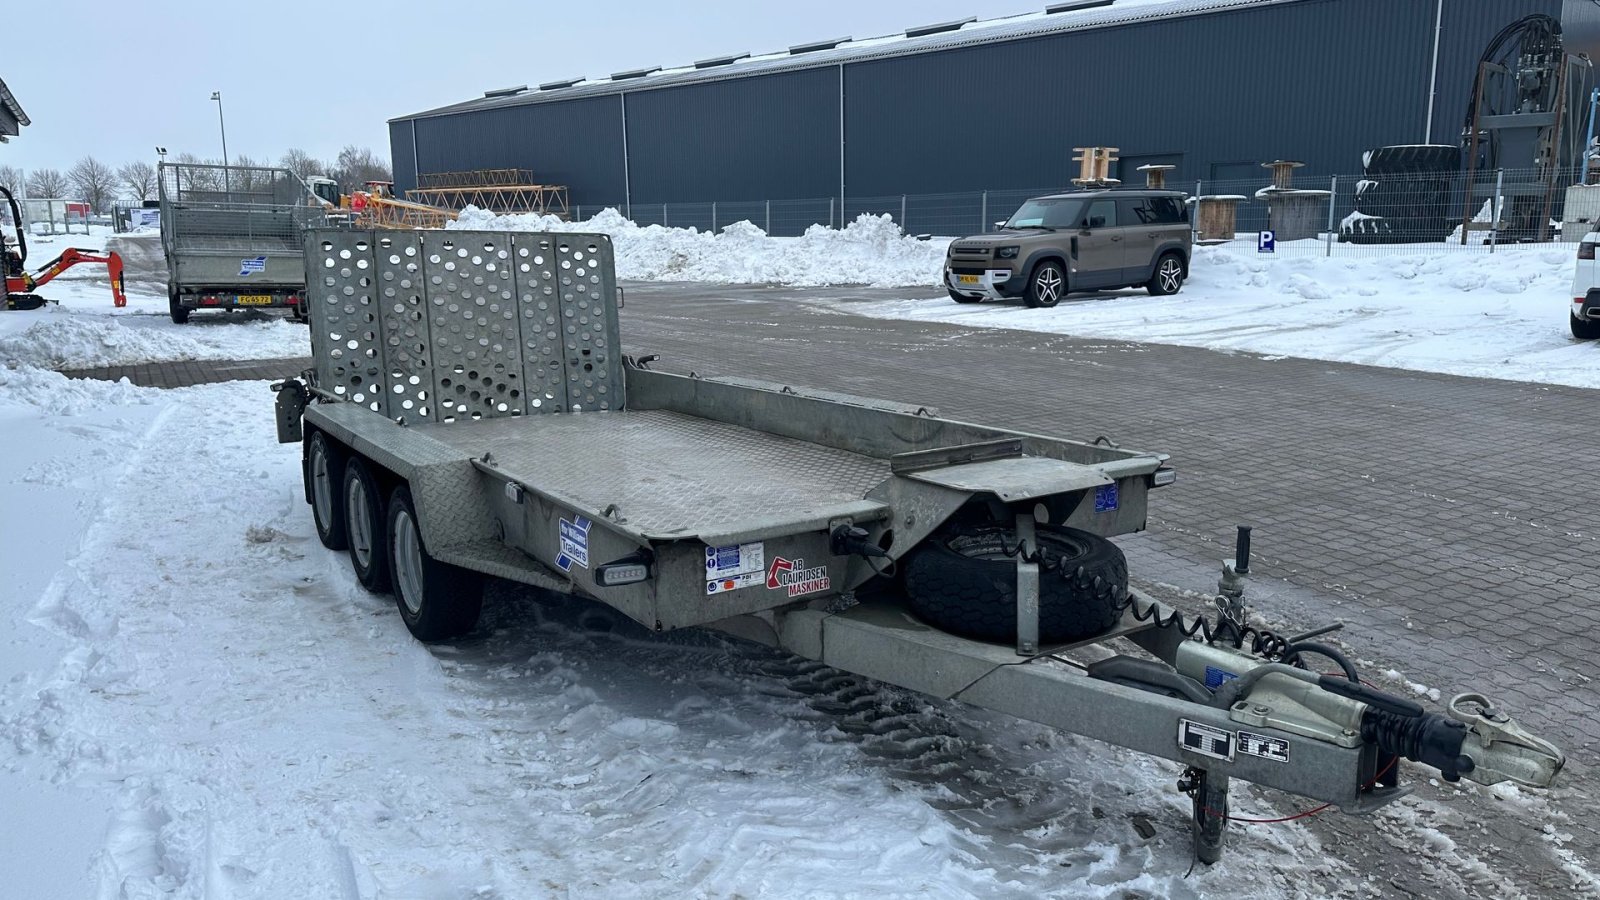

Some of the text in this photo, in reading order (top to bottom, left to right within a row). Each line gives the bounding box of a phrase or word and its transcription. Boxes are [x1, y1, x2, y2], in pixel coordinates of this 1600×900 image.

[1260, 231, 1273, 248] P
[561, 538, 587, 562] Trailers
[793, 559, 803, 571] AB
[783, 566, 826, 586] LAURIDSEN
[789, 577, 830, 596] MASKINER
